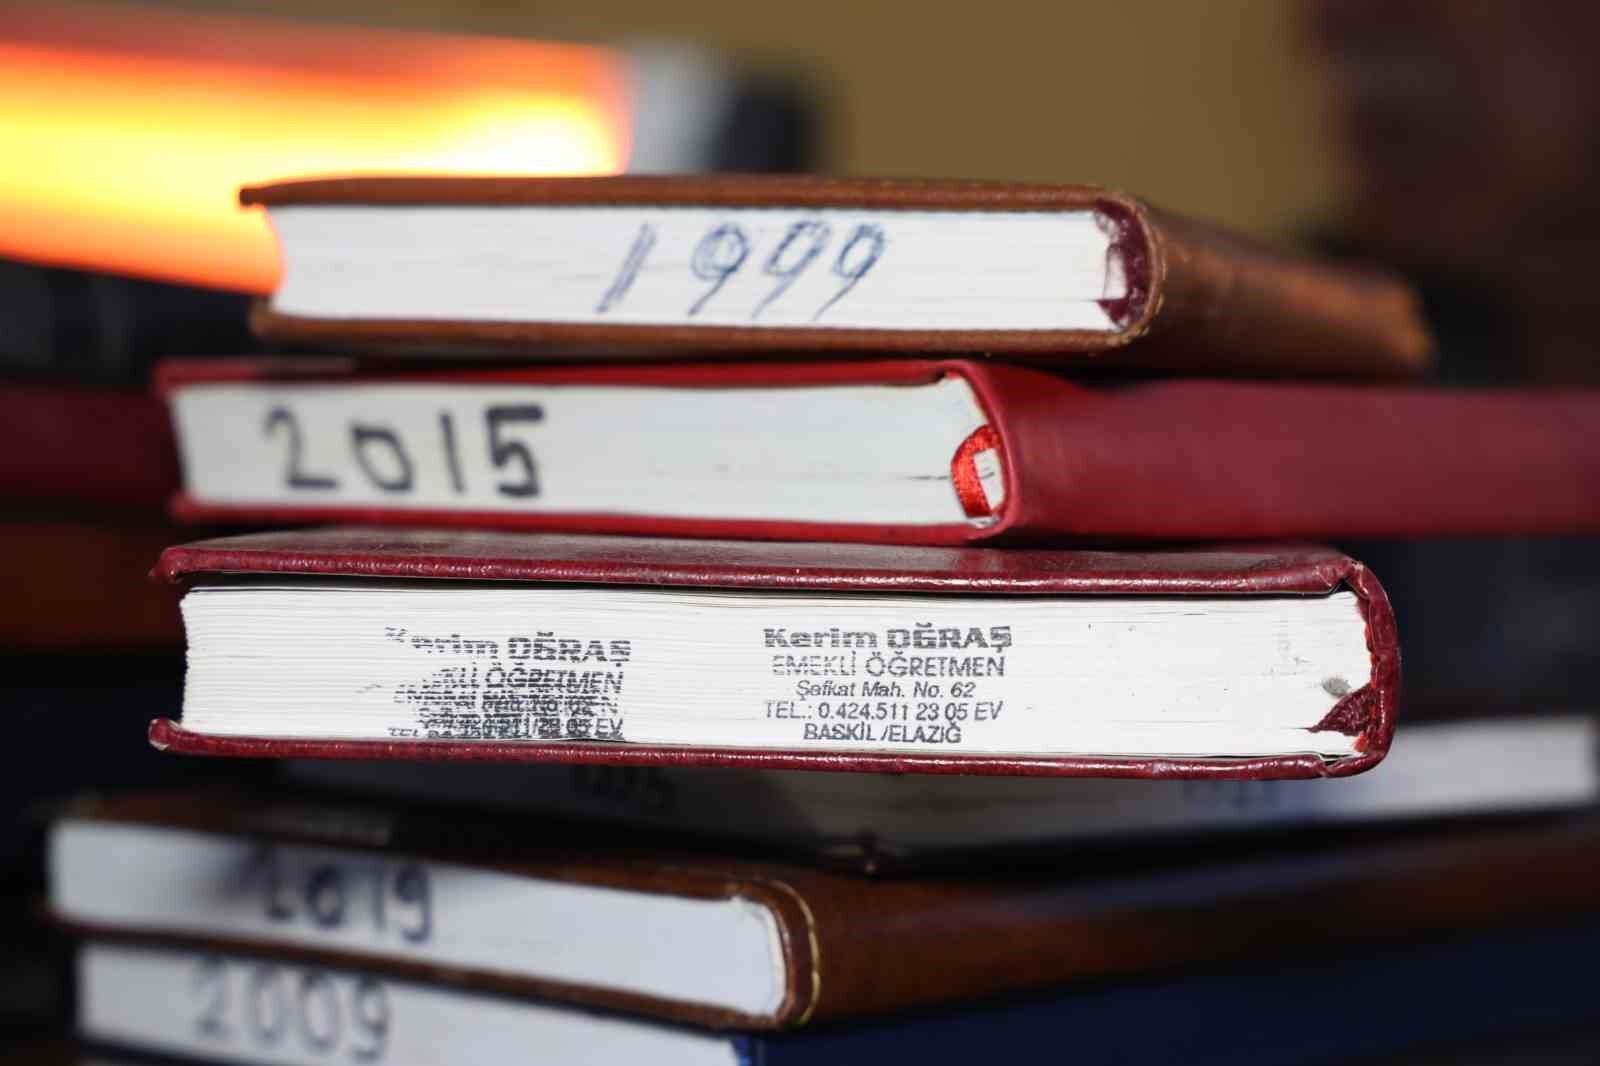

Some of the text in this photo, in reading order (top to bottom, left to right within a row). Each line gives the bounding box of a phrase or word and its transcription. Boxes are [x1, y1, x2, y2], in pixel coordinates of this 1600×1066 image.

[595, 220, 887, 320] 1999
[263, 403, 546, 498] 2015
[764, 628, 878, 648] Kerim
[865, 651, 1006, 677] ÖĞRETMEN
[796, 680, 977, 701] Şefkat Mah. No. 62
[817, 703, 908, 720] 0.424.511
[915, 703, 939, 720] 23
[945, 703, 968, 720] 05
[974, 701, 1003, 719] EV
[190, 956, 390, 1061] 2009
